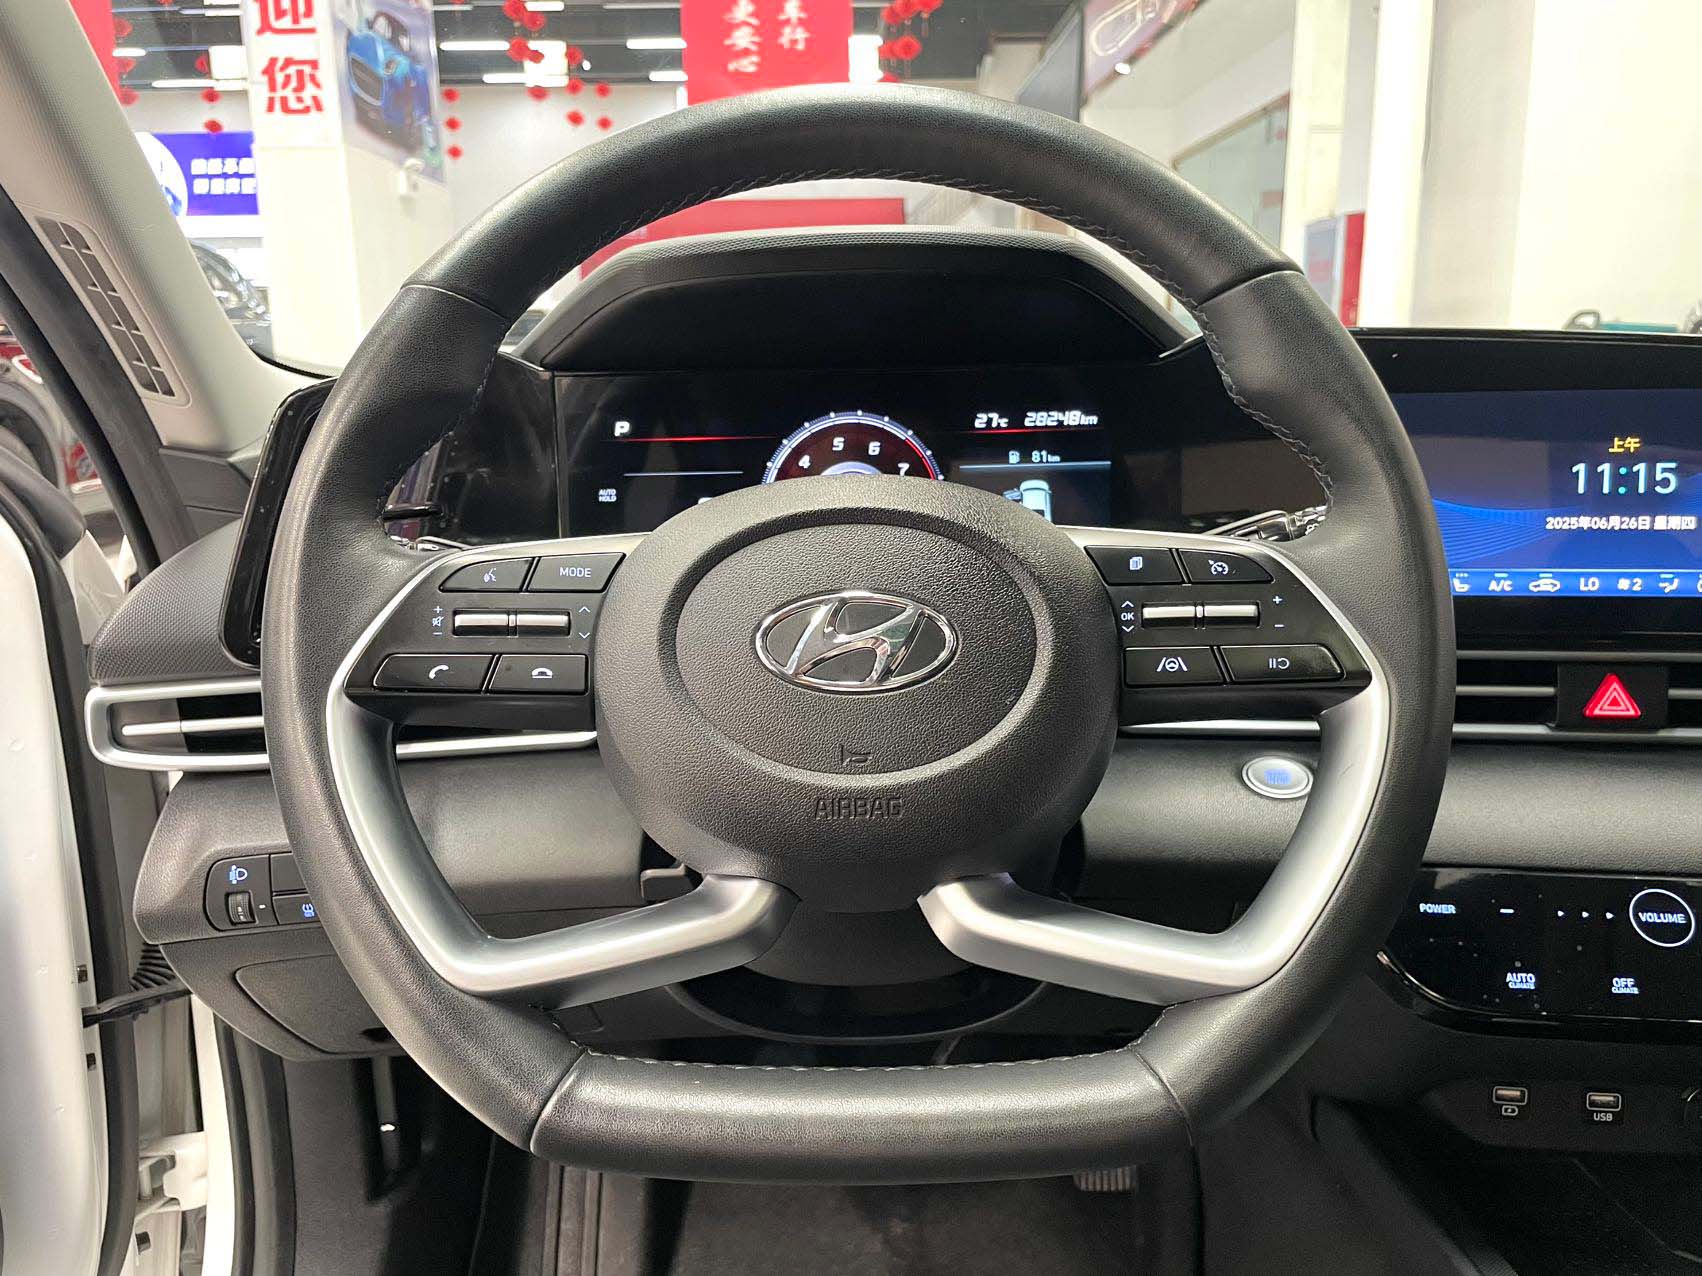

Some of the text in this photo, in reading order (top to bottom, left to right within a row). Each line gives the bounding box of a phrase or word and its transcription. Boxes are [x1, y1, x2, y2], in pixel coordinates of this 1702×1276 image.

[614, 421, 631, 437] P
[832, 436, 845, 451] 5
[868, 441, 881, 456] 6
[1608, 437, 1641, 453] 上午
[798, 455, 811, 469] 4
[897, 462, 910, 476] 7
[1571, 462, 1679, 495] 11:15
[598, 488, 617, 496] AUTO
[1545, 515, 1698, 530] 2025年06月26日 星期四
[559, 567, 592, 578] MODE
[1488, 579, 1513, 592] A/C
[1579, 576, 1600, 592] LO
[1632, 577, 1643, 592] 2
[1120, 612, 1135, 622] OK
[815, 797, 903, 820] AIRBAG
[1419, 902, 1457, 915] POWER
[1638, 911, 1687, 924] VOLUME
[1506, 972, 1536, 983] AUTO
[1612, 977, 1635, 988] OFF
[1593, 1112, 1613, 1122] USB
